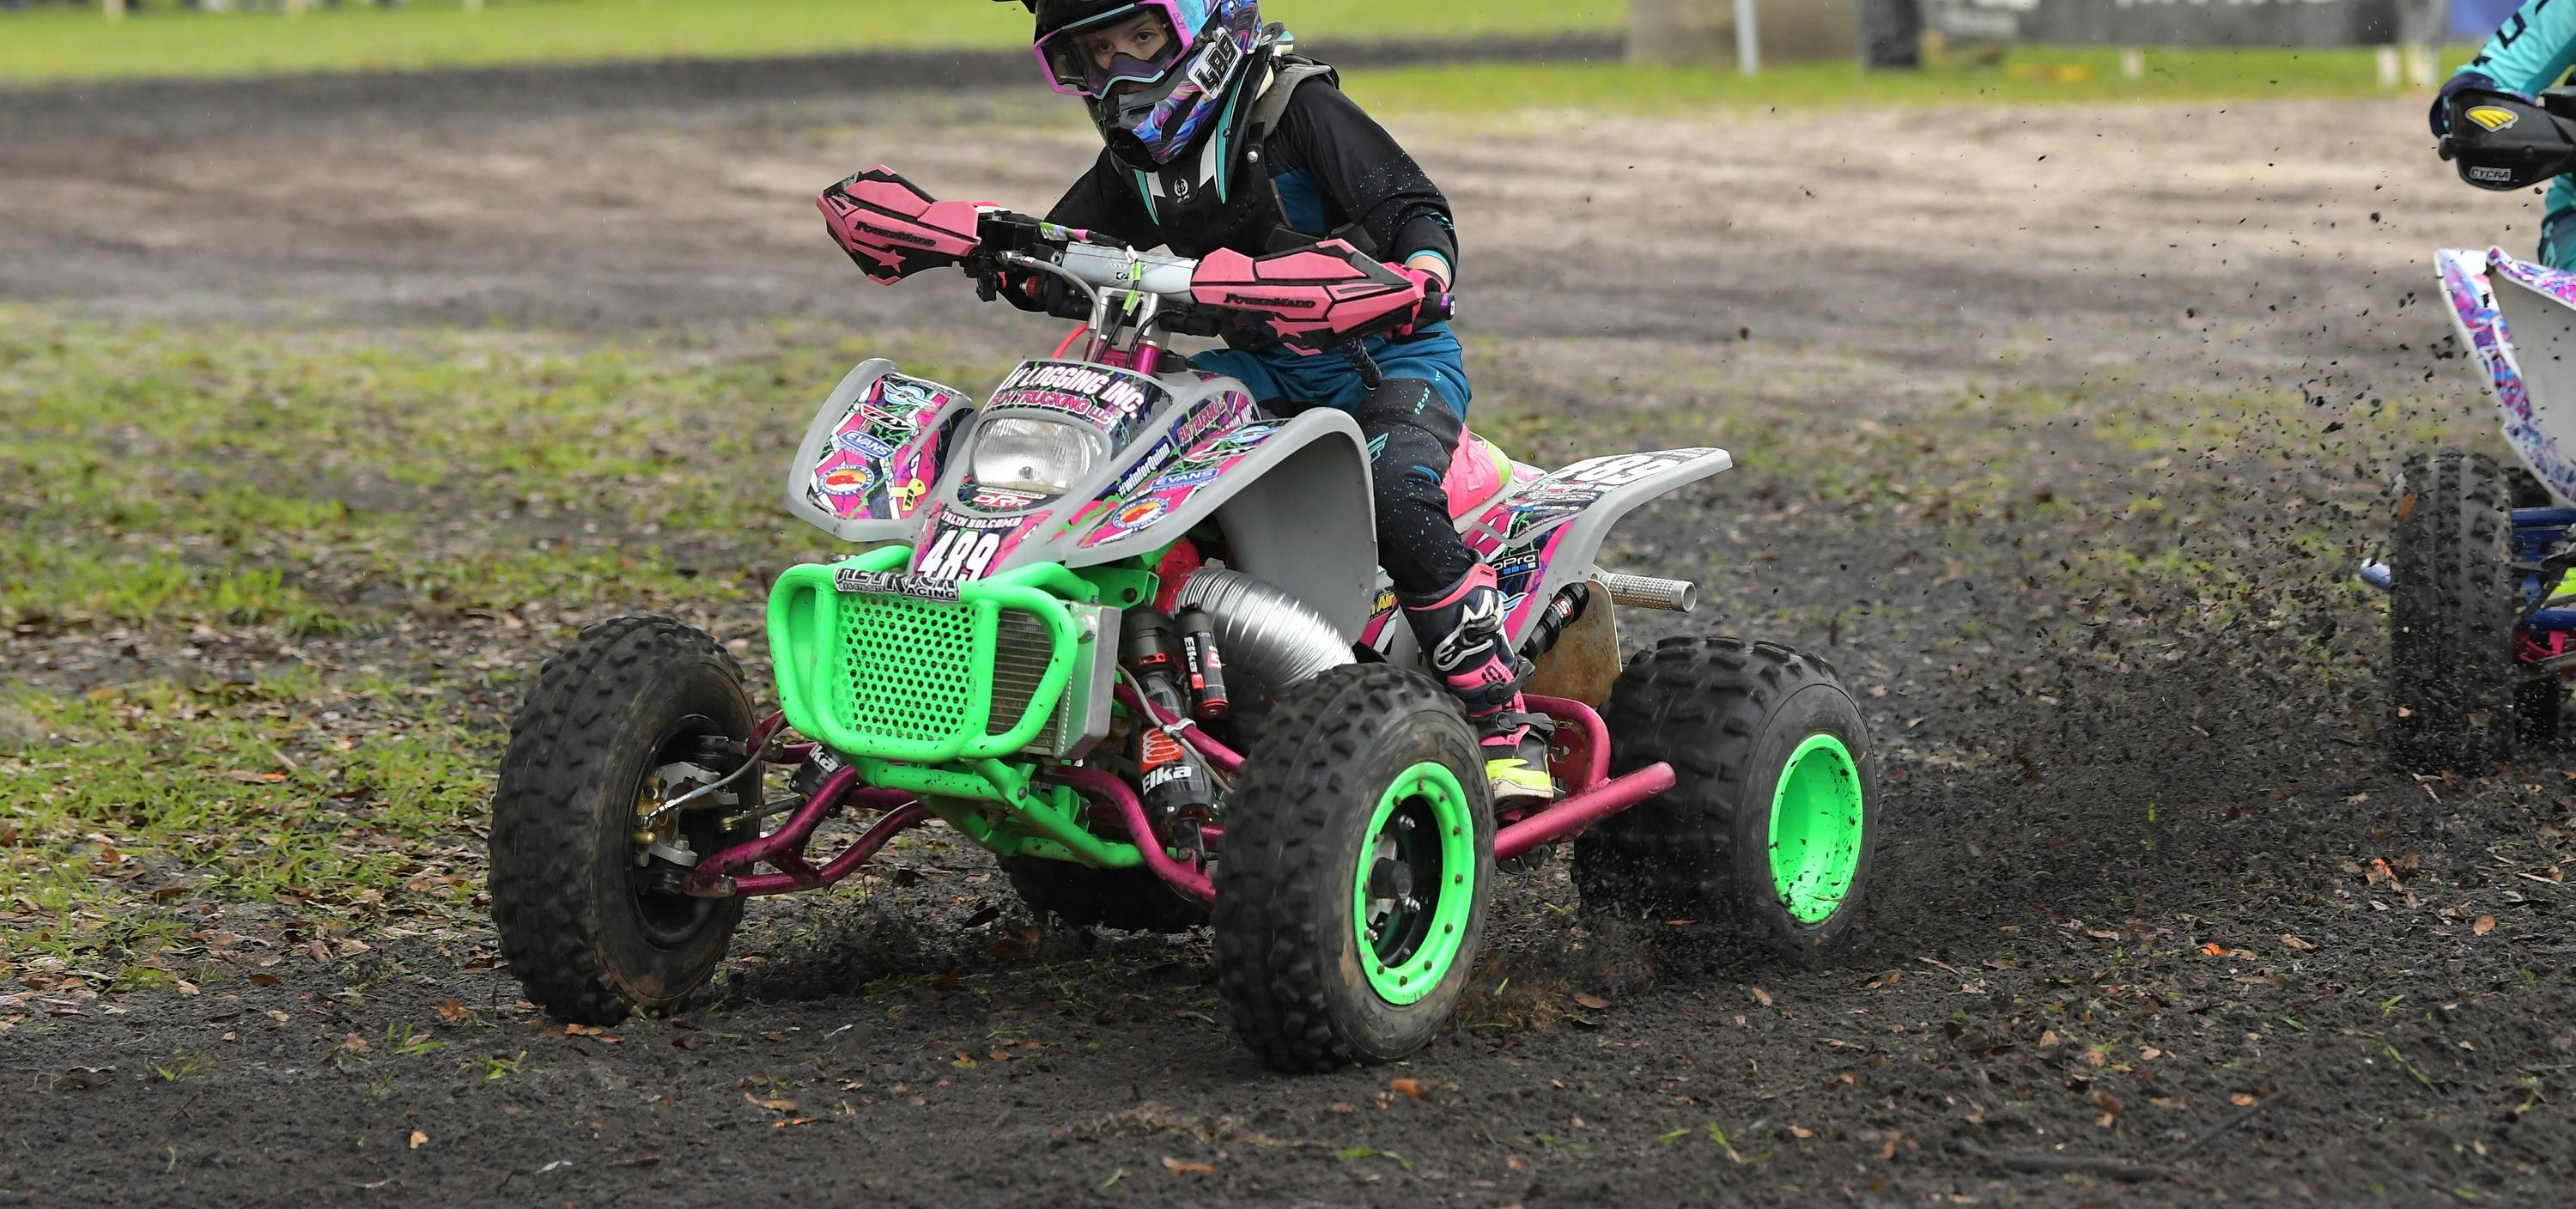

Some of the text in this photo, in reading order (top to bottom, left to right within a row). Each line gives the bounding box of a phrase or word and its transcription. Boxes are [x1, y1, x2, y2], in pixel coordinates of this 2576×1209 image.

[1016, 391, 1092, 414] TRUCKING
[1088, 406, 1114, 423] LLC
[1022, 366, 1109, 395] LOGGING
[1099, 380, 1145, 419] INC.
[848, 432, 891, 456] EVANS
[1118, 442, 1170, 498] #winforQuinn
[968, 516, 1023, 528] HOLCOMB
[917, 530, 1001, 582] 489
[1492, 555, 1535, 570] oPro
[1184, 636, 1198, 673] Elka
[811, 745, 838, 772] lka
[1142, 765, 1192, 796] Elka
